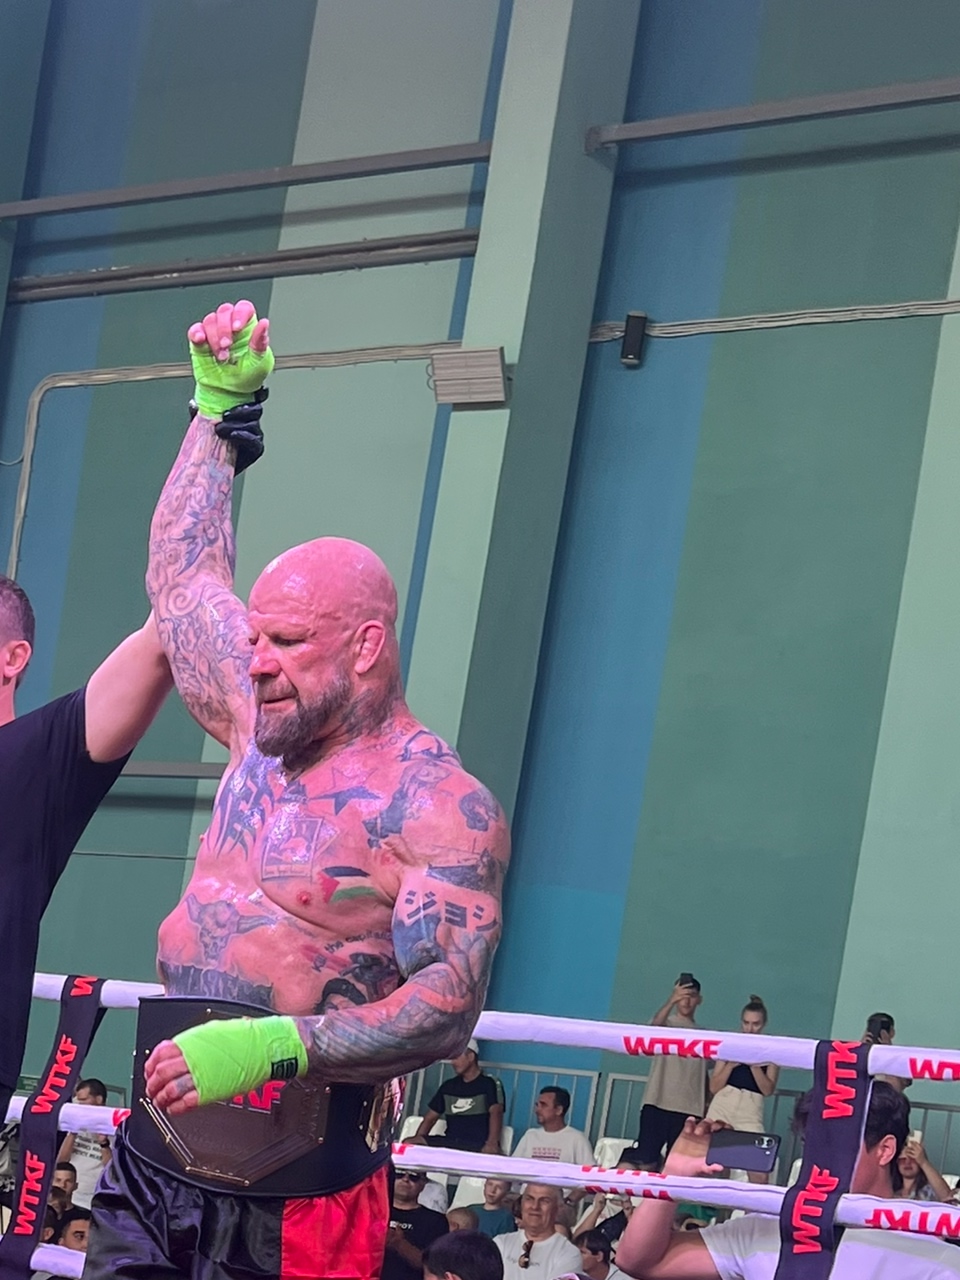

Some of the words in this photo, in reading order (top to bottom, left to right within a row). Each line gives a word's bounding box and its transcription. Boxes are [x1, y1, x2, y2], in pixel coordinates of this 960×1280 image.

[31, 1034, 78, 1114] WTKF
[623, 1035, 723, 1060] WTKF
[822, 1039, 863, 1119] WTK
[13, 1150, 47, 1235] WTKF
[792, 1164, 840, 1254] WTKF
